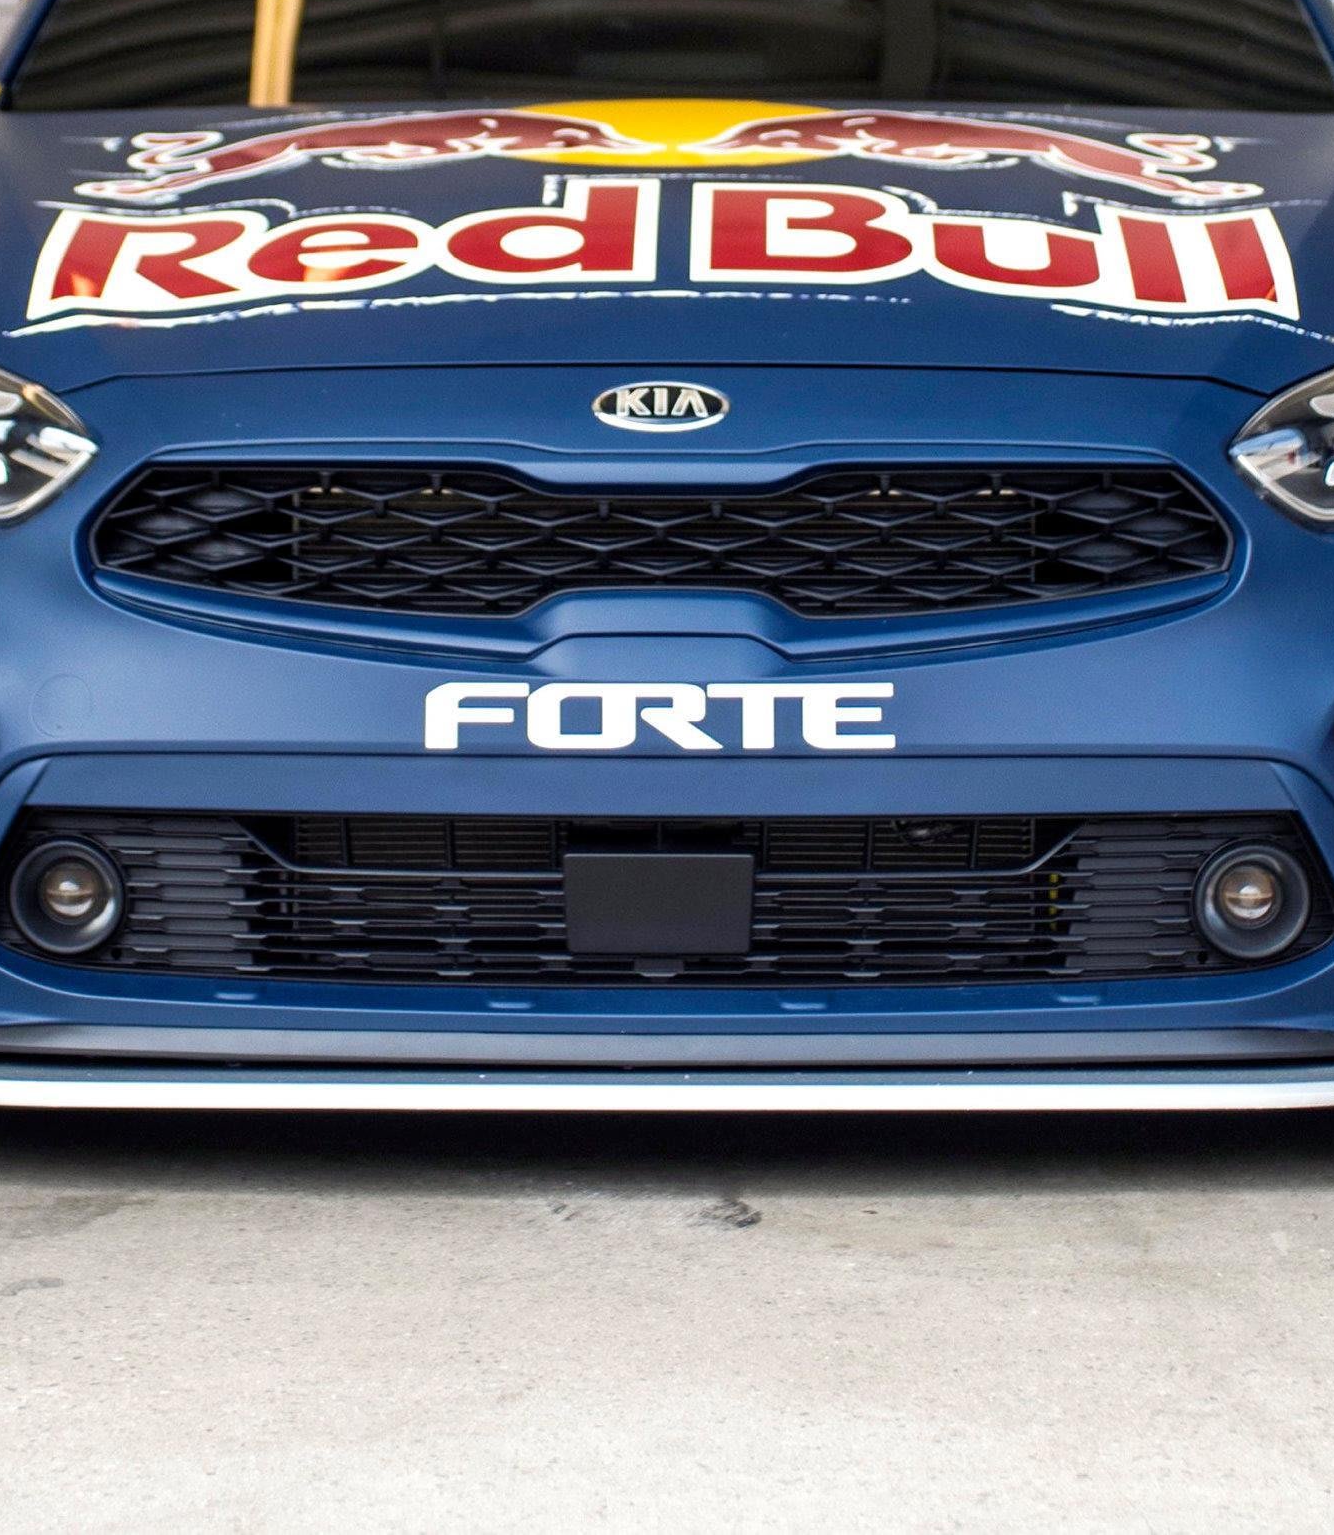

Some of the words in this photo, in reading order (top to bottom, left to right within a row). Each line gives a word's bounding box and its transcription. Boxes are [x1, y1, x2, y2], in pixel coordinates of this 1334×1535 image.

[45, 186, 643, 302] Red
[703, 188, 1280, 306] Bull
[615, 386, 710, 419] KIA
[424, 682, 896, 750] FORTE
